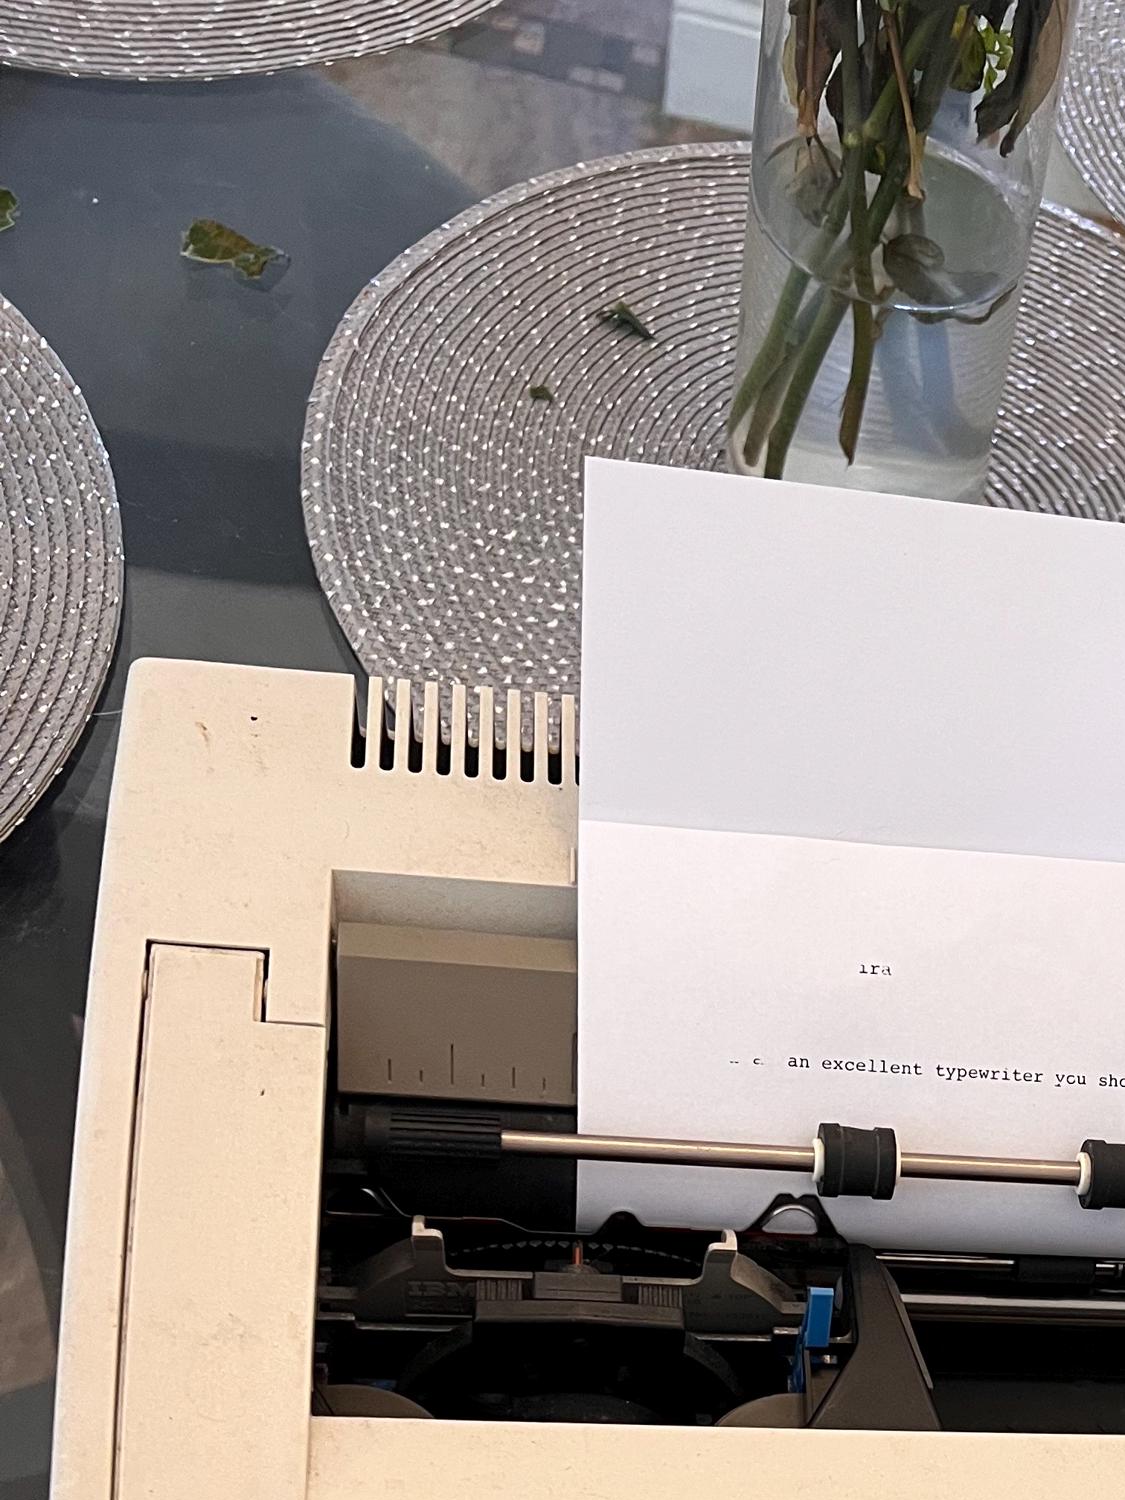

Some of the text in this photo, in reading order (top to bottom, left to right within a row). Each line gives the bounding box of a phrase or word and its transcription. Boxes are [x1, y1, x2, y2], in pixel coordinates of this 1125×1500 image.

[787, 1056, 810, 1069] an
[821, 1058, 923, 1076] excellent
[935, 1064, 1044, 1084] typewriter
